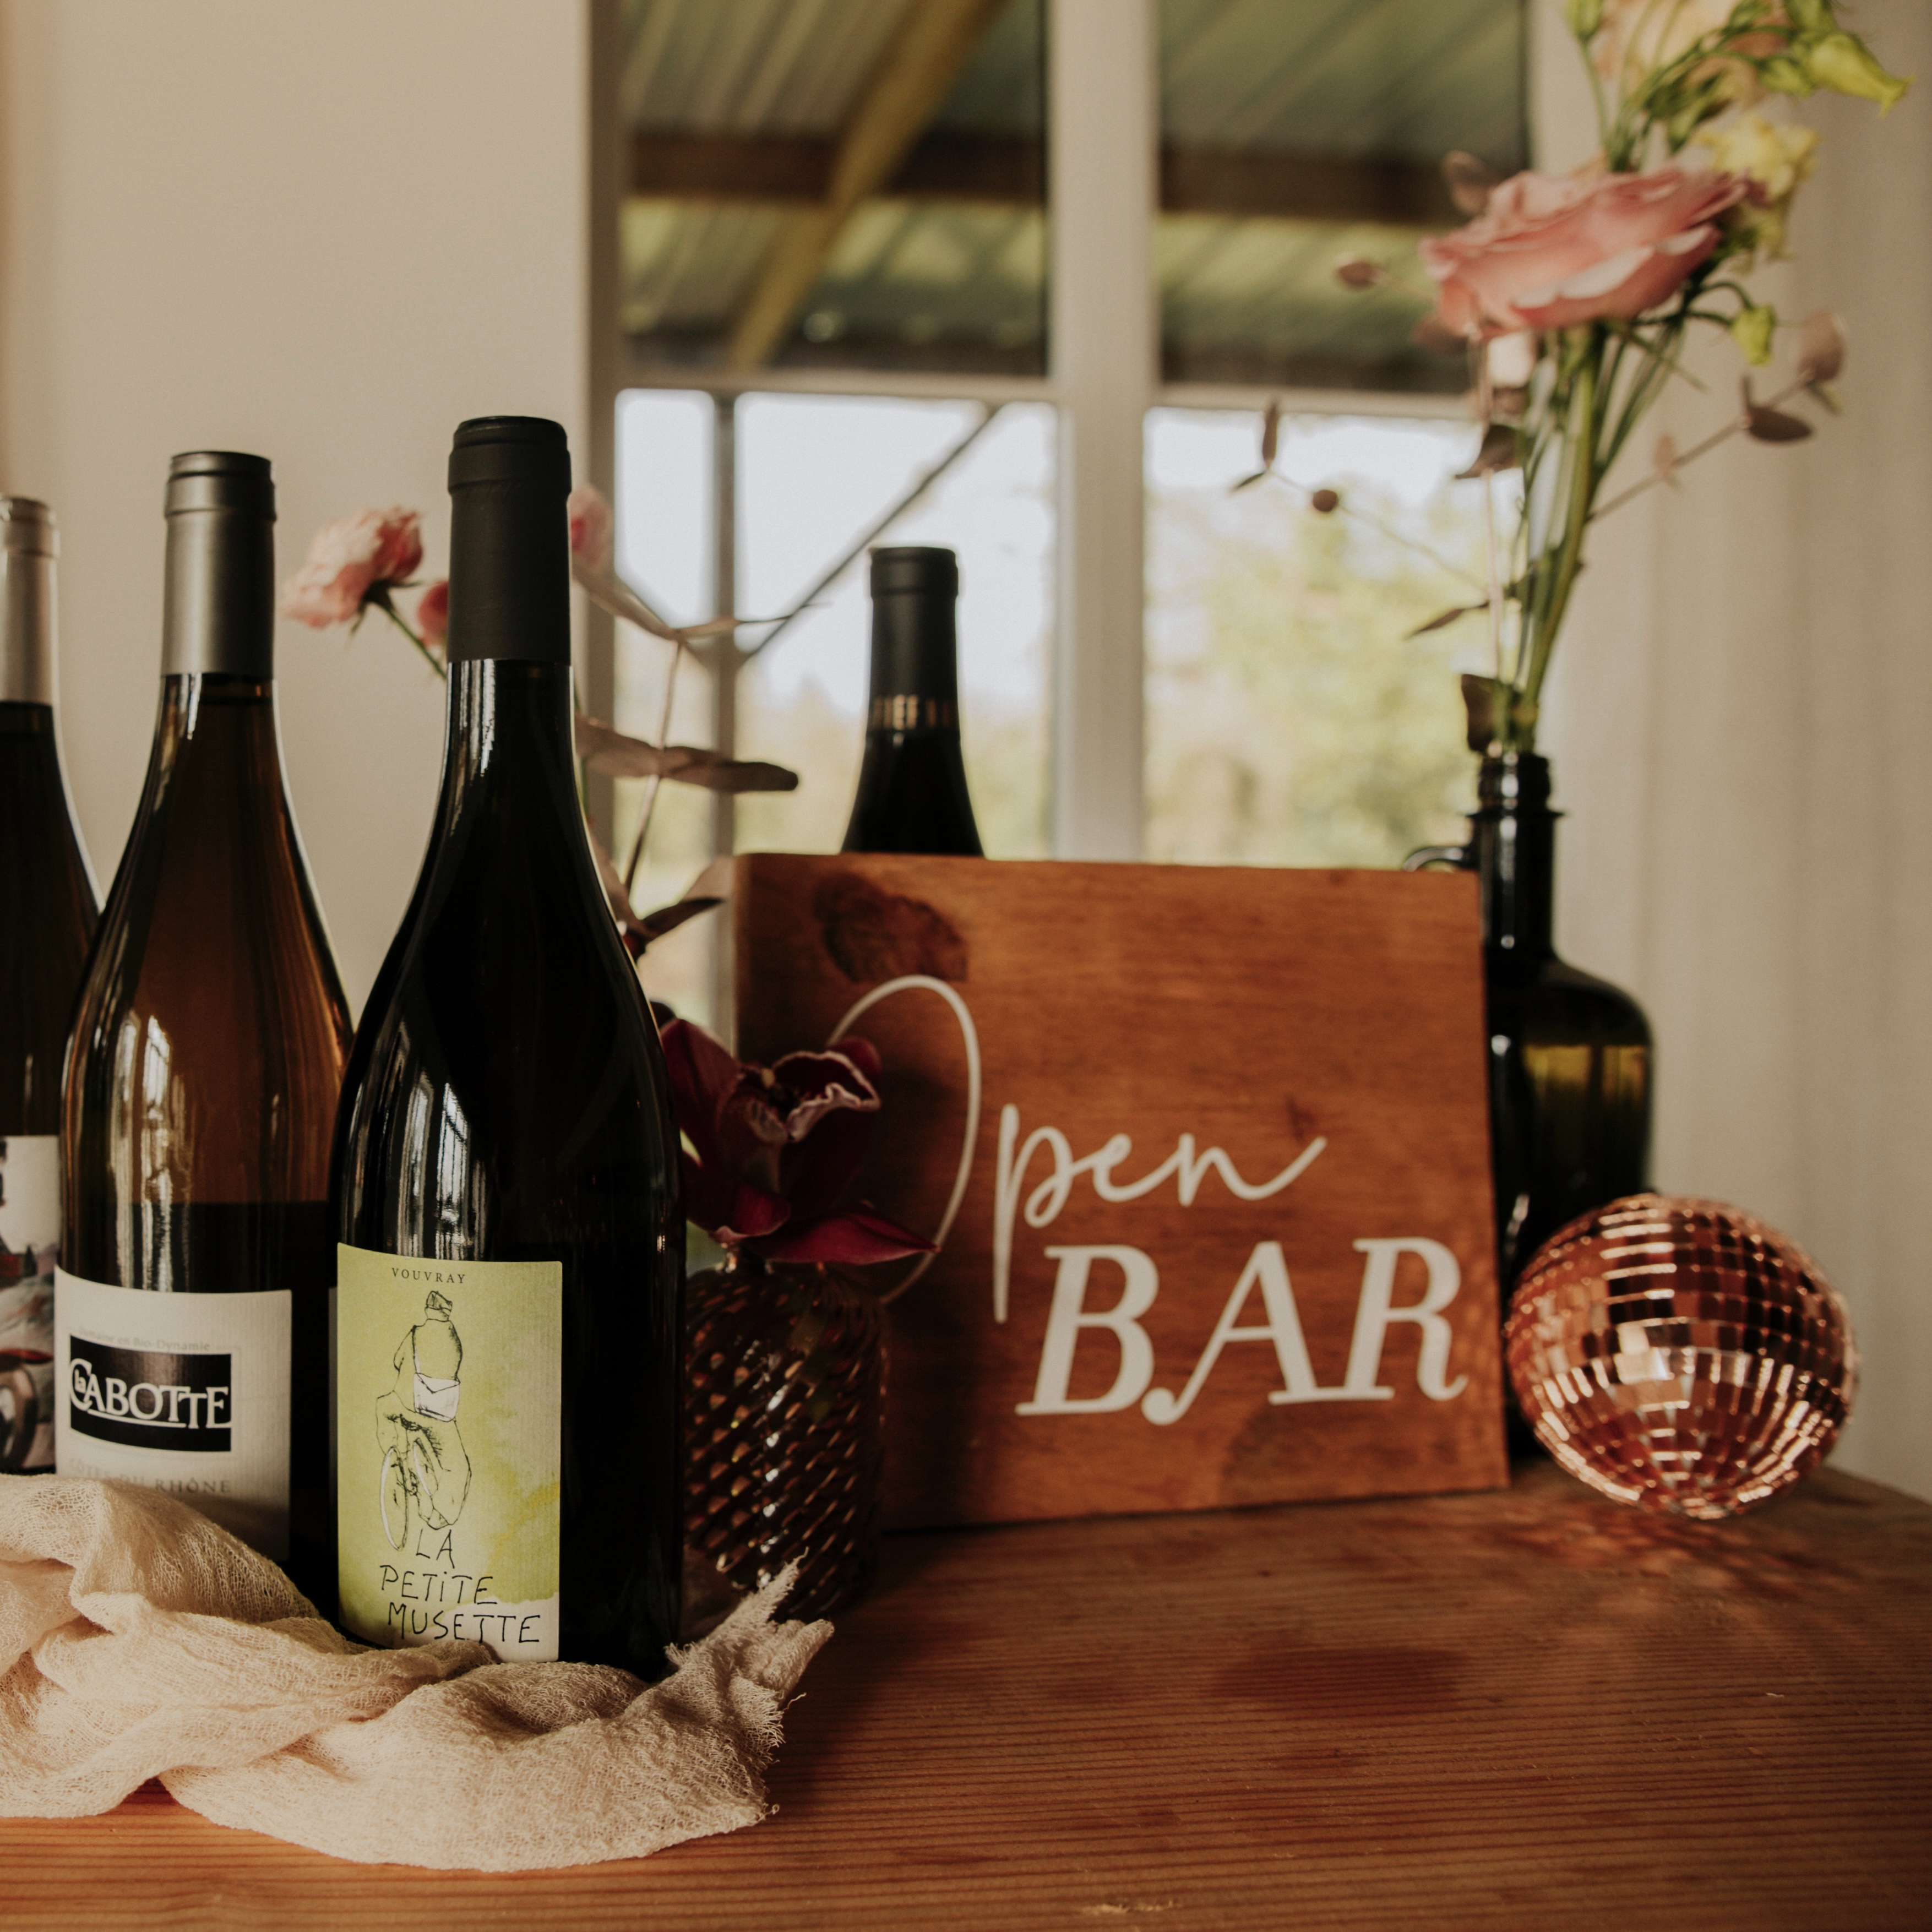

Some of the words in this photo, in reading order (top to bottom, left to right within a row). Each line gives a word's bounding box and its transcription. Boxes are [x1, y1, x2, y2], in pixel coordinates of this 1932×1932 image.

[391, 1267, 465, 1284] VOUVRAY
[1016, 1237, 1469, 1426] BAR
[70, 1358, 232, 1429] CABOTTE
[155, 1477, 232, 1493] RHÔNE
[415, 1528, 455, 1569] LA
[388, 1602, 541, 1643] MUSETTE
